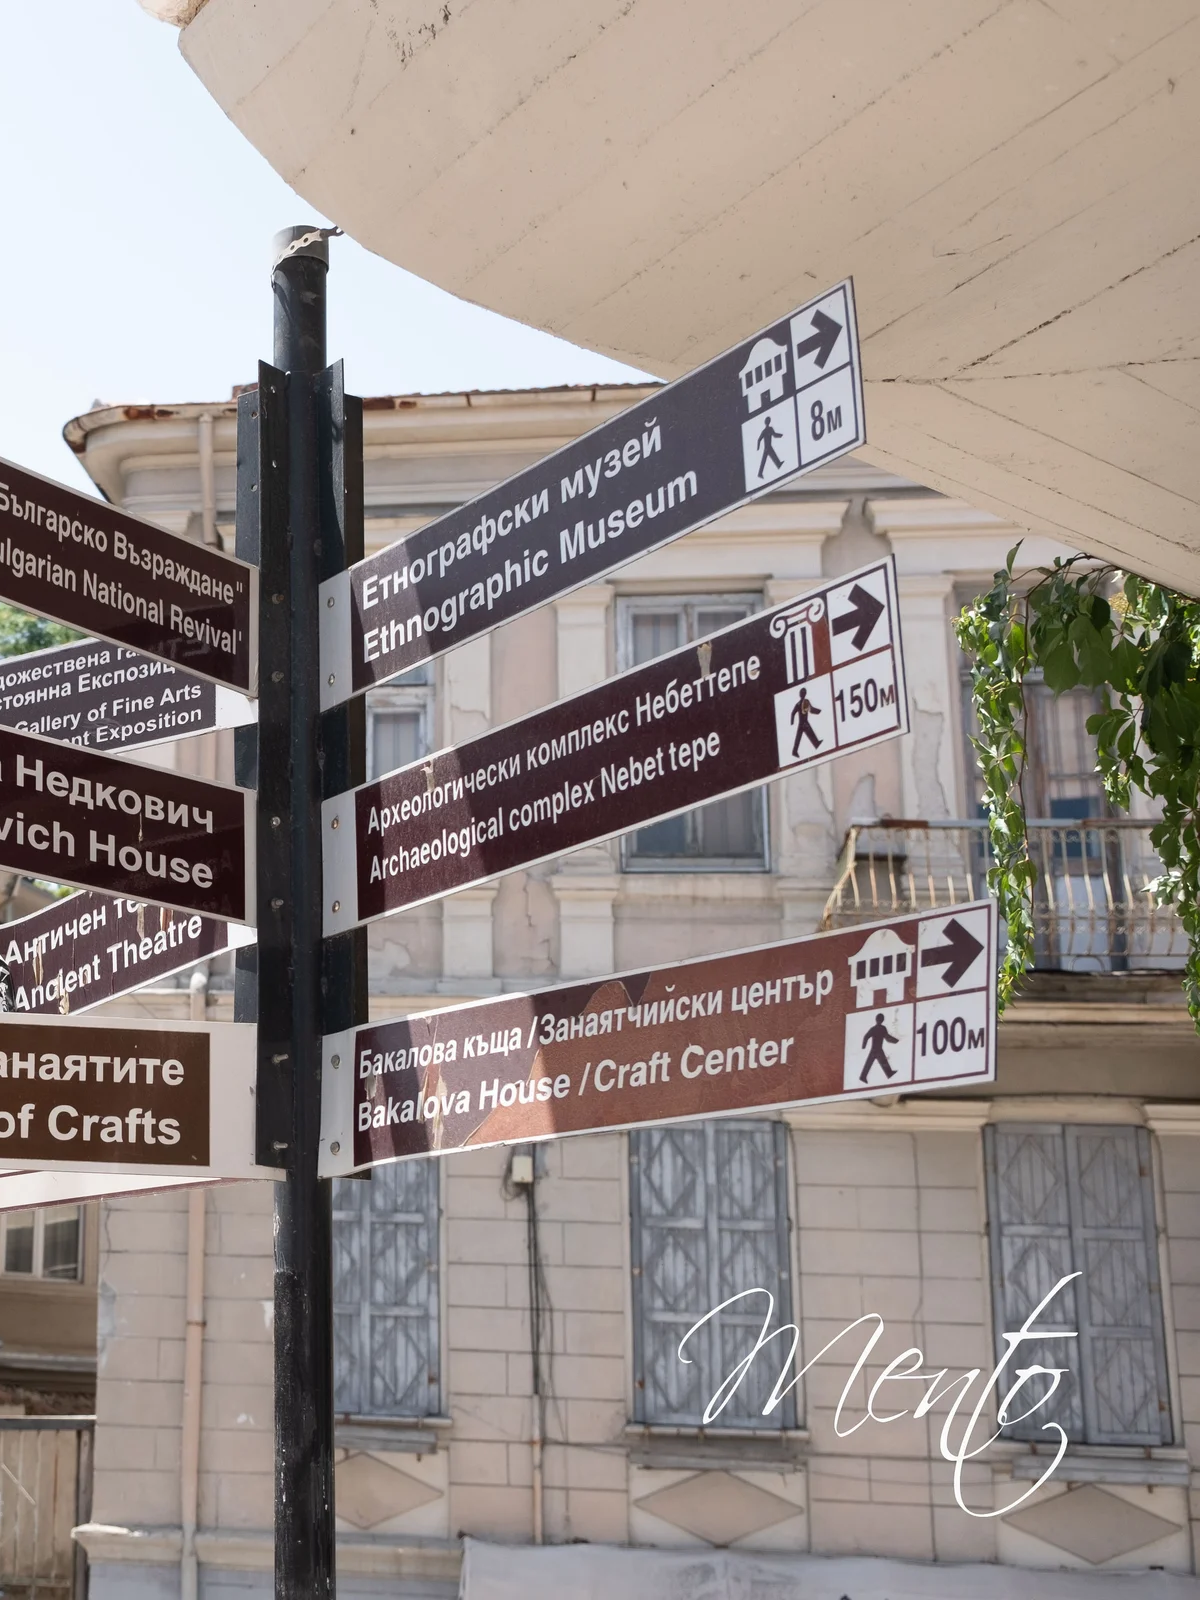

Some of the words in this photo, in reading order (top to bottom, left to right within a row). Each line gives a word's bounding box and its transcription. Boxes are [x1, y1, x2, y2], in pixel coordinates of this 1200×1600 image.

[363, 486, 549, 610] Етнографски
[561, 416, 663, 505] музей
[83, 571, 164, 625] National
[364, 548, 548, 663] Ethnographic
[559, 469, 698, 563] Museum
[87, 702, 108, 722] of
[113, 691, 154, 717] Fine
[160, 683, 202, 706] Arts
[97, 706, 202, 744] Exposition
[16, 755, 214, 835] Недкович
[368, 753, 520, 837] Археологически
[527, 709, 630, 771] комплекс
[370, 807, 503, 884] Archaeological
[509, 779, 595, 831] complex
[601, 747, 665, 797] Nebet
[669, 731, 721, 774] tepe
[88, 829, 213, 890] House
[4, 905, 106, 966] Античен
[15, 955, 101, 1012] Ancient
[107, 915, 202, 974] Theatre
[359, 1039, 457, 1079] Бакалова
[463, 1027, 522, 1059] къща
[731, 968, 833, 1020] център
[47, 1105, 182, 1146] Crafts
[358, 1088, 470, 1132] Bakalova
[478, 1073, 570, 1111] House
[688, 1034, 794, 1079] Center
